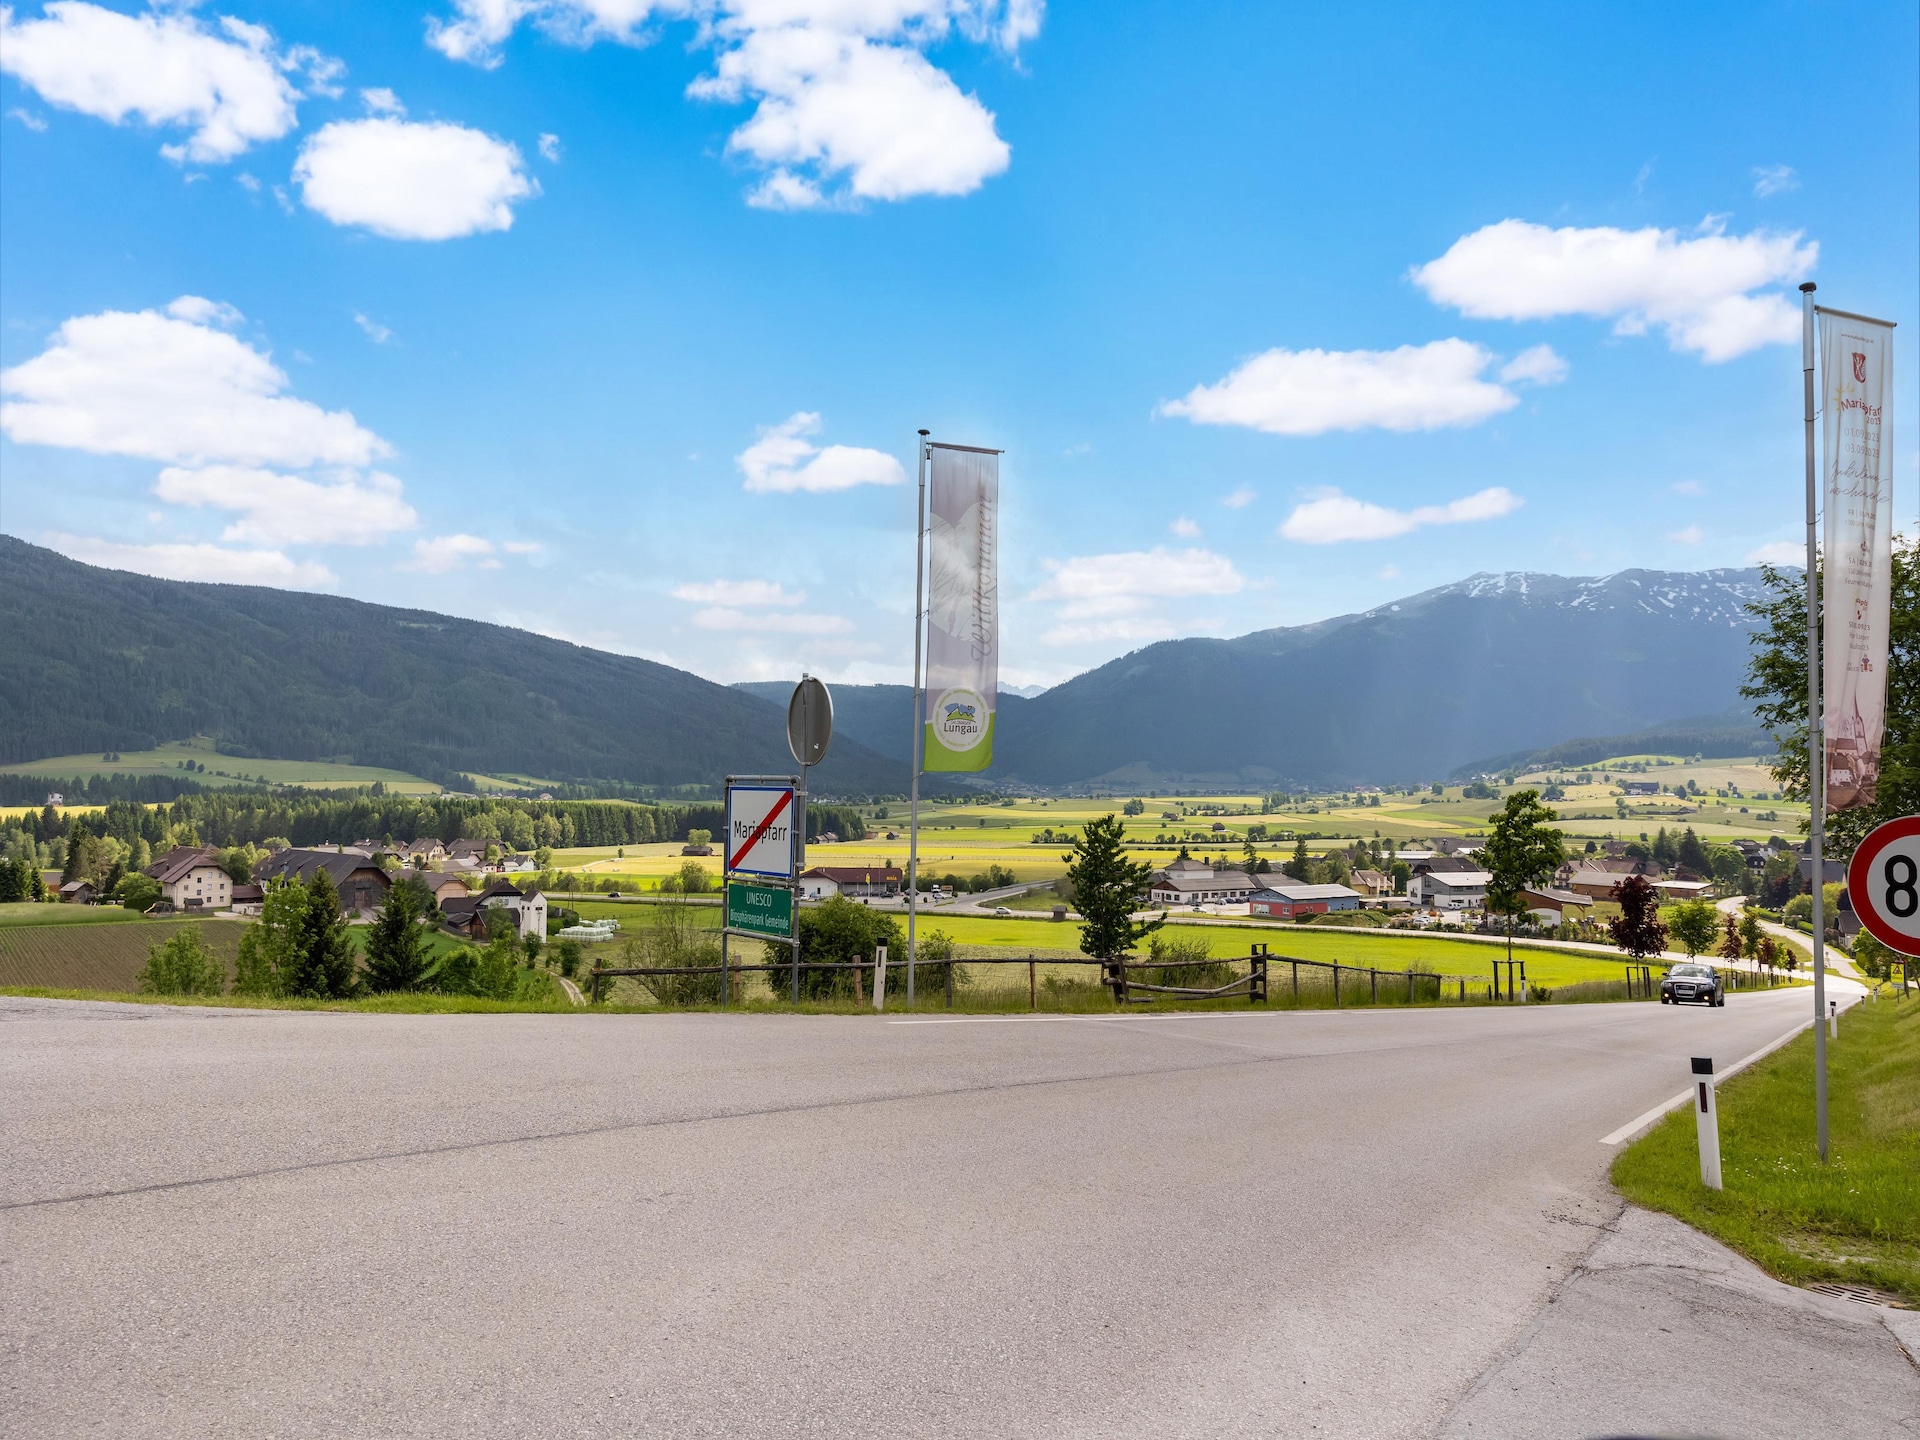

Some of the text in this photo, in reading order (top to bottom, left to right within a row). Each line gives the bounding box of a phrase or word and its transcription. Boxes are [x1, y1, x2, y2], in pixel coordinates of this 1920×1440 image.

[971, 496, 998, 662] Willkommen
[943, 722, 978, 735] Lungau
[733, 820, 787, 844] Mariapfarr
[1885, 854, 1918, 918] 8
[746, 891, 772, 907] UNESCO
[730, 908, 788, 930] Biosphärenpark Gemeinde
